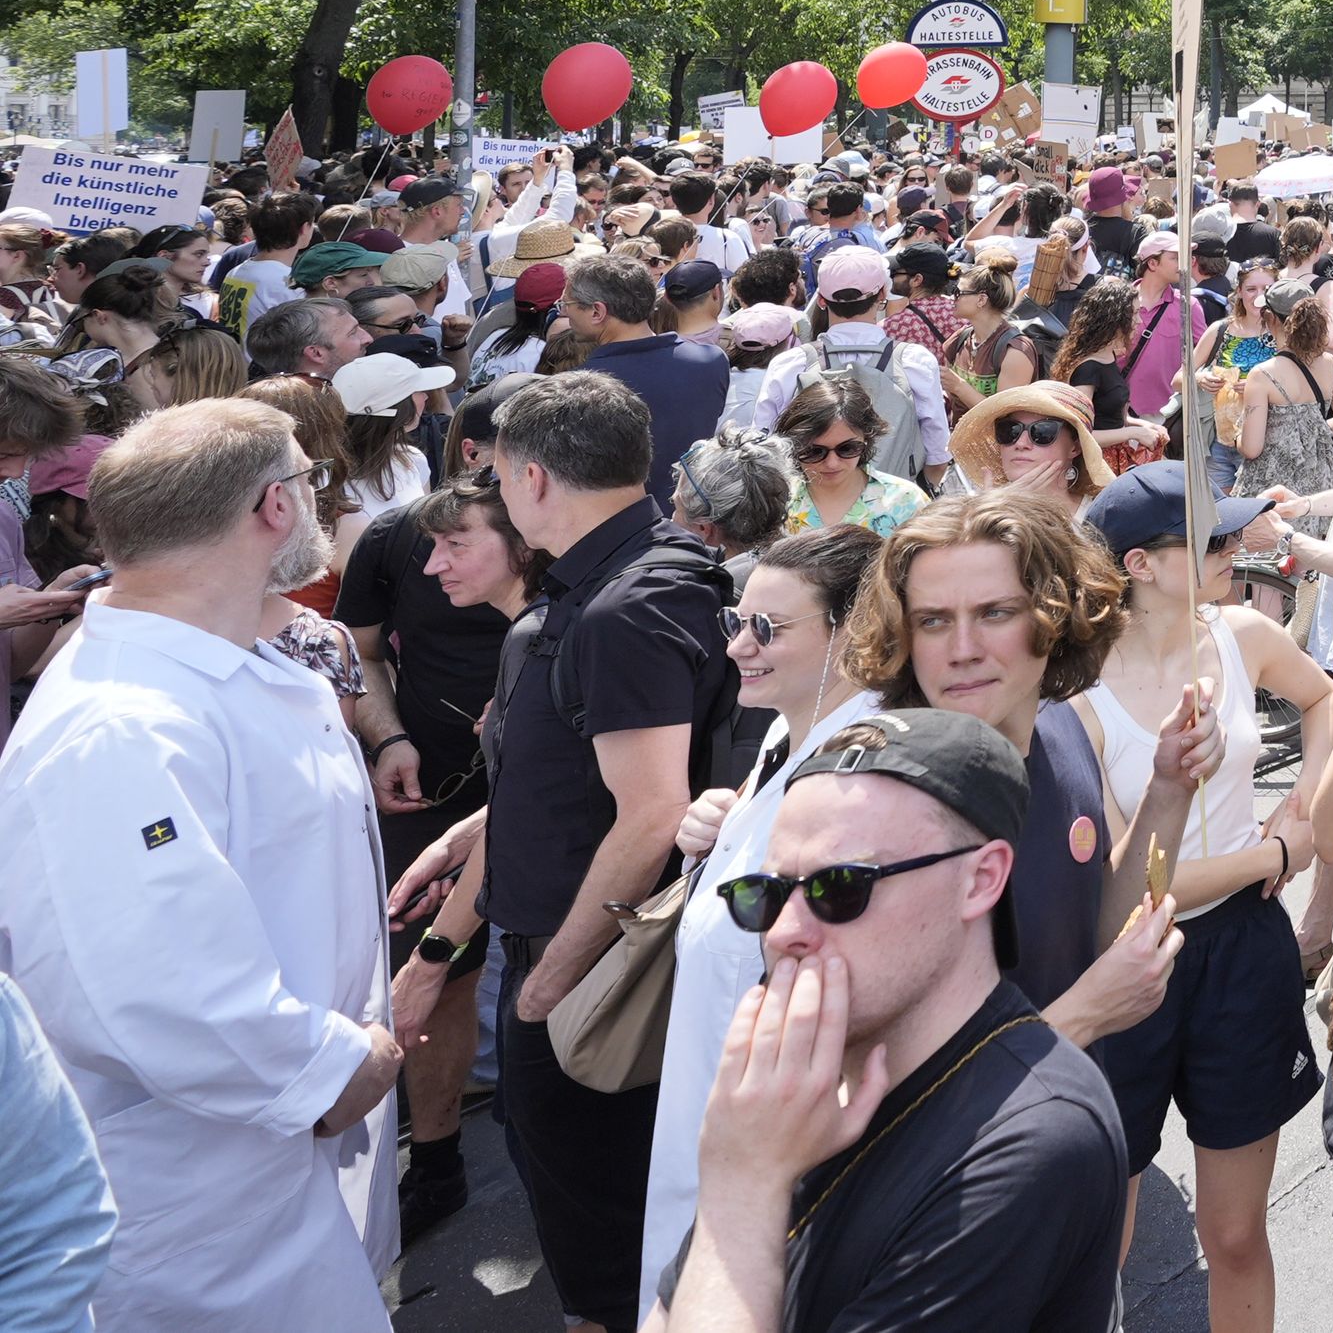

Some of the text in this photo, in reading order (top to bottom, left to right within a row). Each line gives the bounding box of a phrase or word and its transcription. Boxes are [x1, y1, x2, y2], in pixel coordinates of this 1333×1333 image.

[931, 5, 986, 22] AUTOBUS
[920, 31, 994, 42] HALTESTELLE
[921, 91, 990, 112] HALTESTELLE
[984, 130, 993, 138] D
[483, 141, 498, 151] Bis
[53, 152, 179, 179] Bis nur mehr
[479, 156, 494, 165] die
[42, 171, 178, 199] die künstliche
[53, 193, 157, 217] Intelligenz
